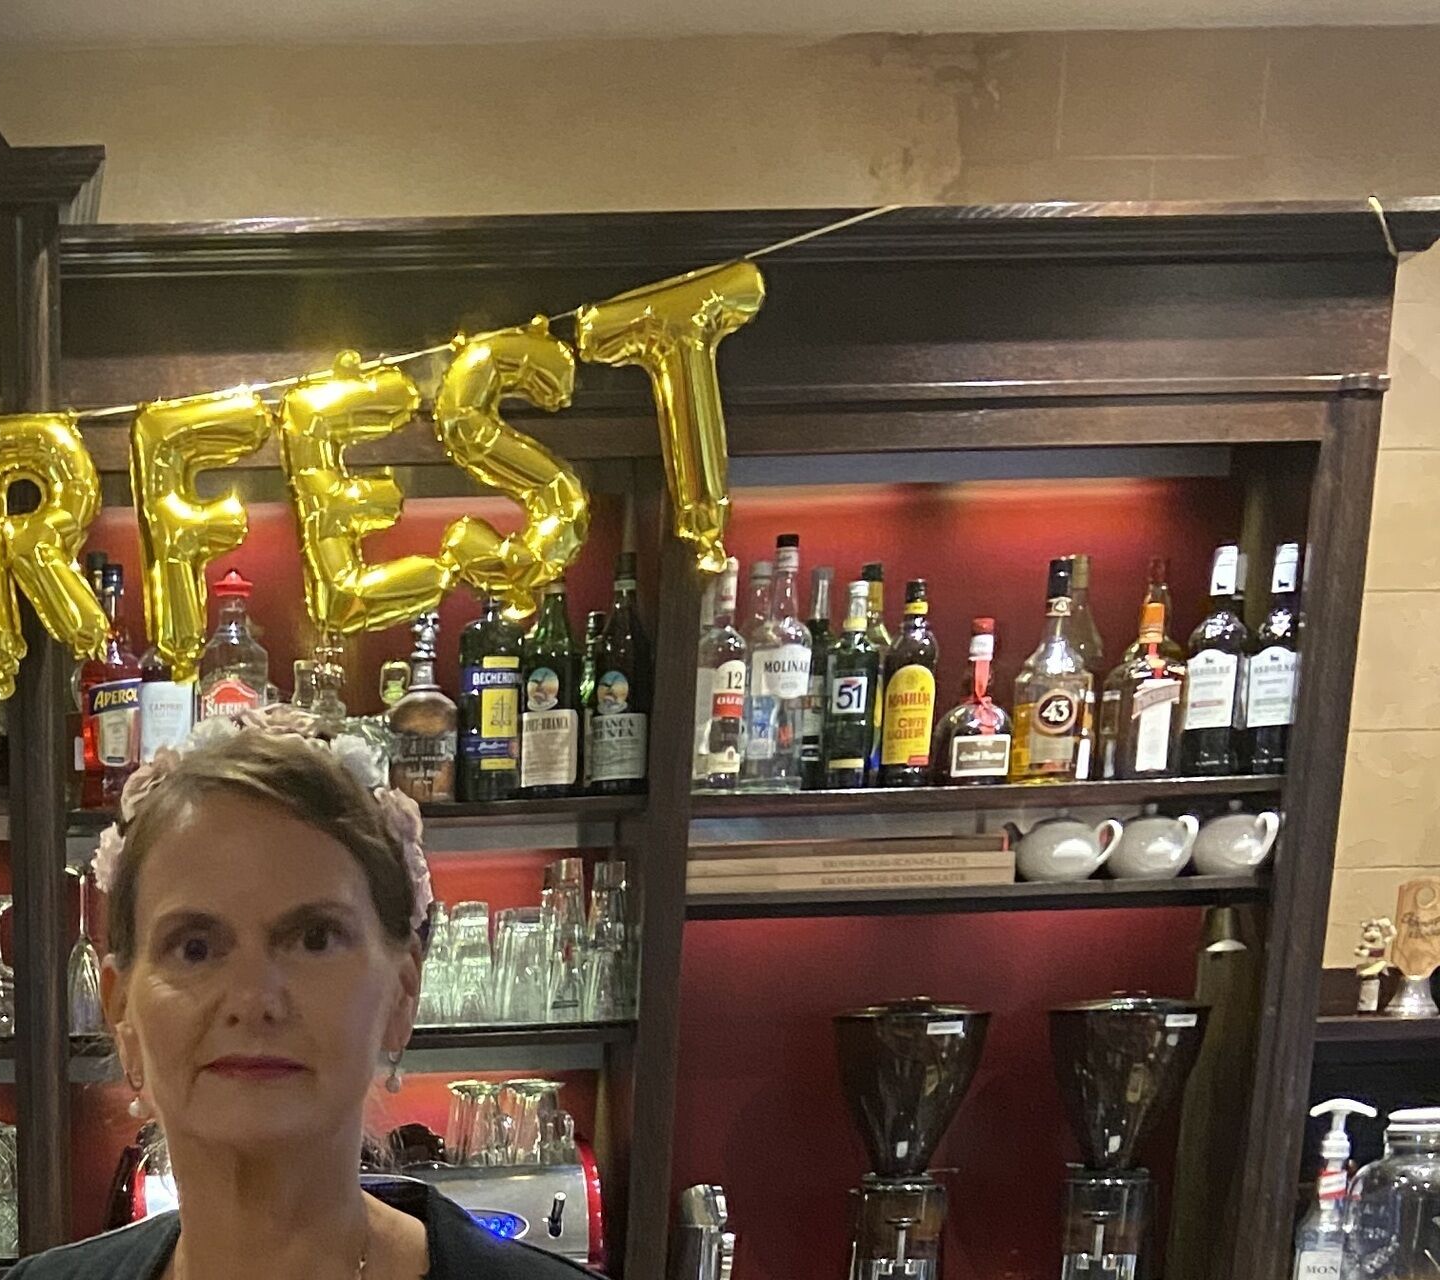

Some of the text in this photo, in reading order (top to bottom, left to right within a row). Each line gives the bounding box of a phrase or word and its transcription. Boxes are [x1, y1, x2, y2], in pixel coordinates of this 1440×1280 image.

[726, 670, 743, 690] 12
[837, 683, 862, 710] 51
[1040, 699, 1070, 723] 43
[1304, 1264, 1339, 1275] MON
